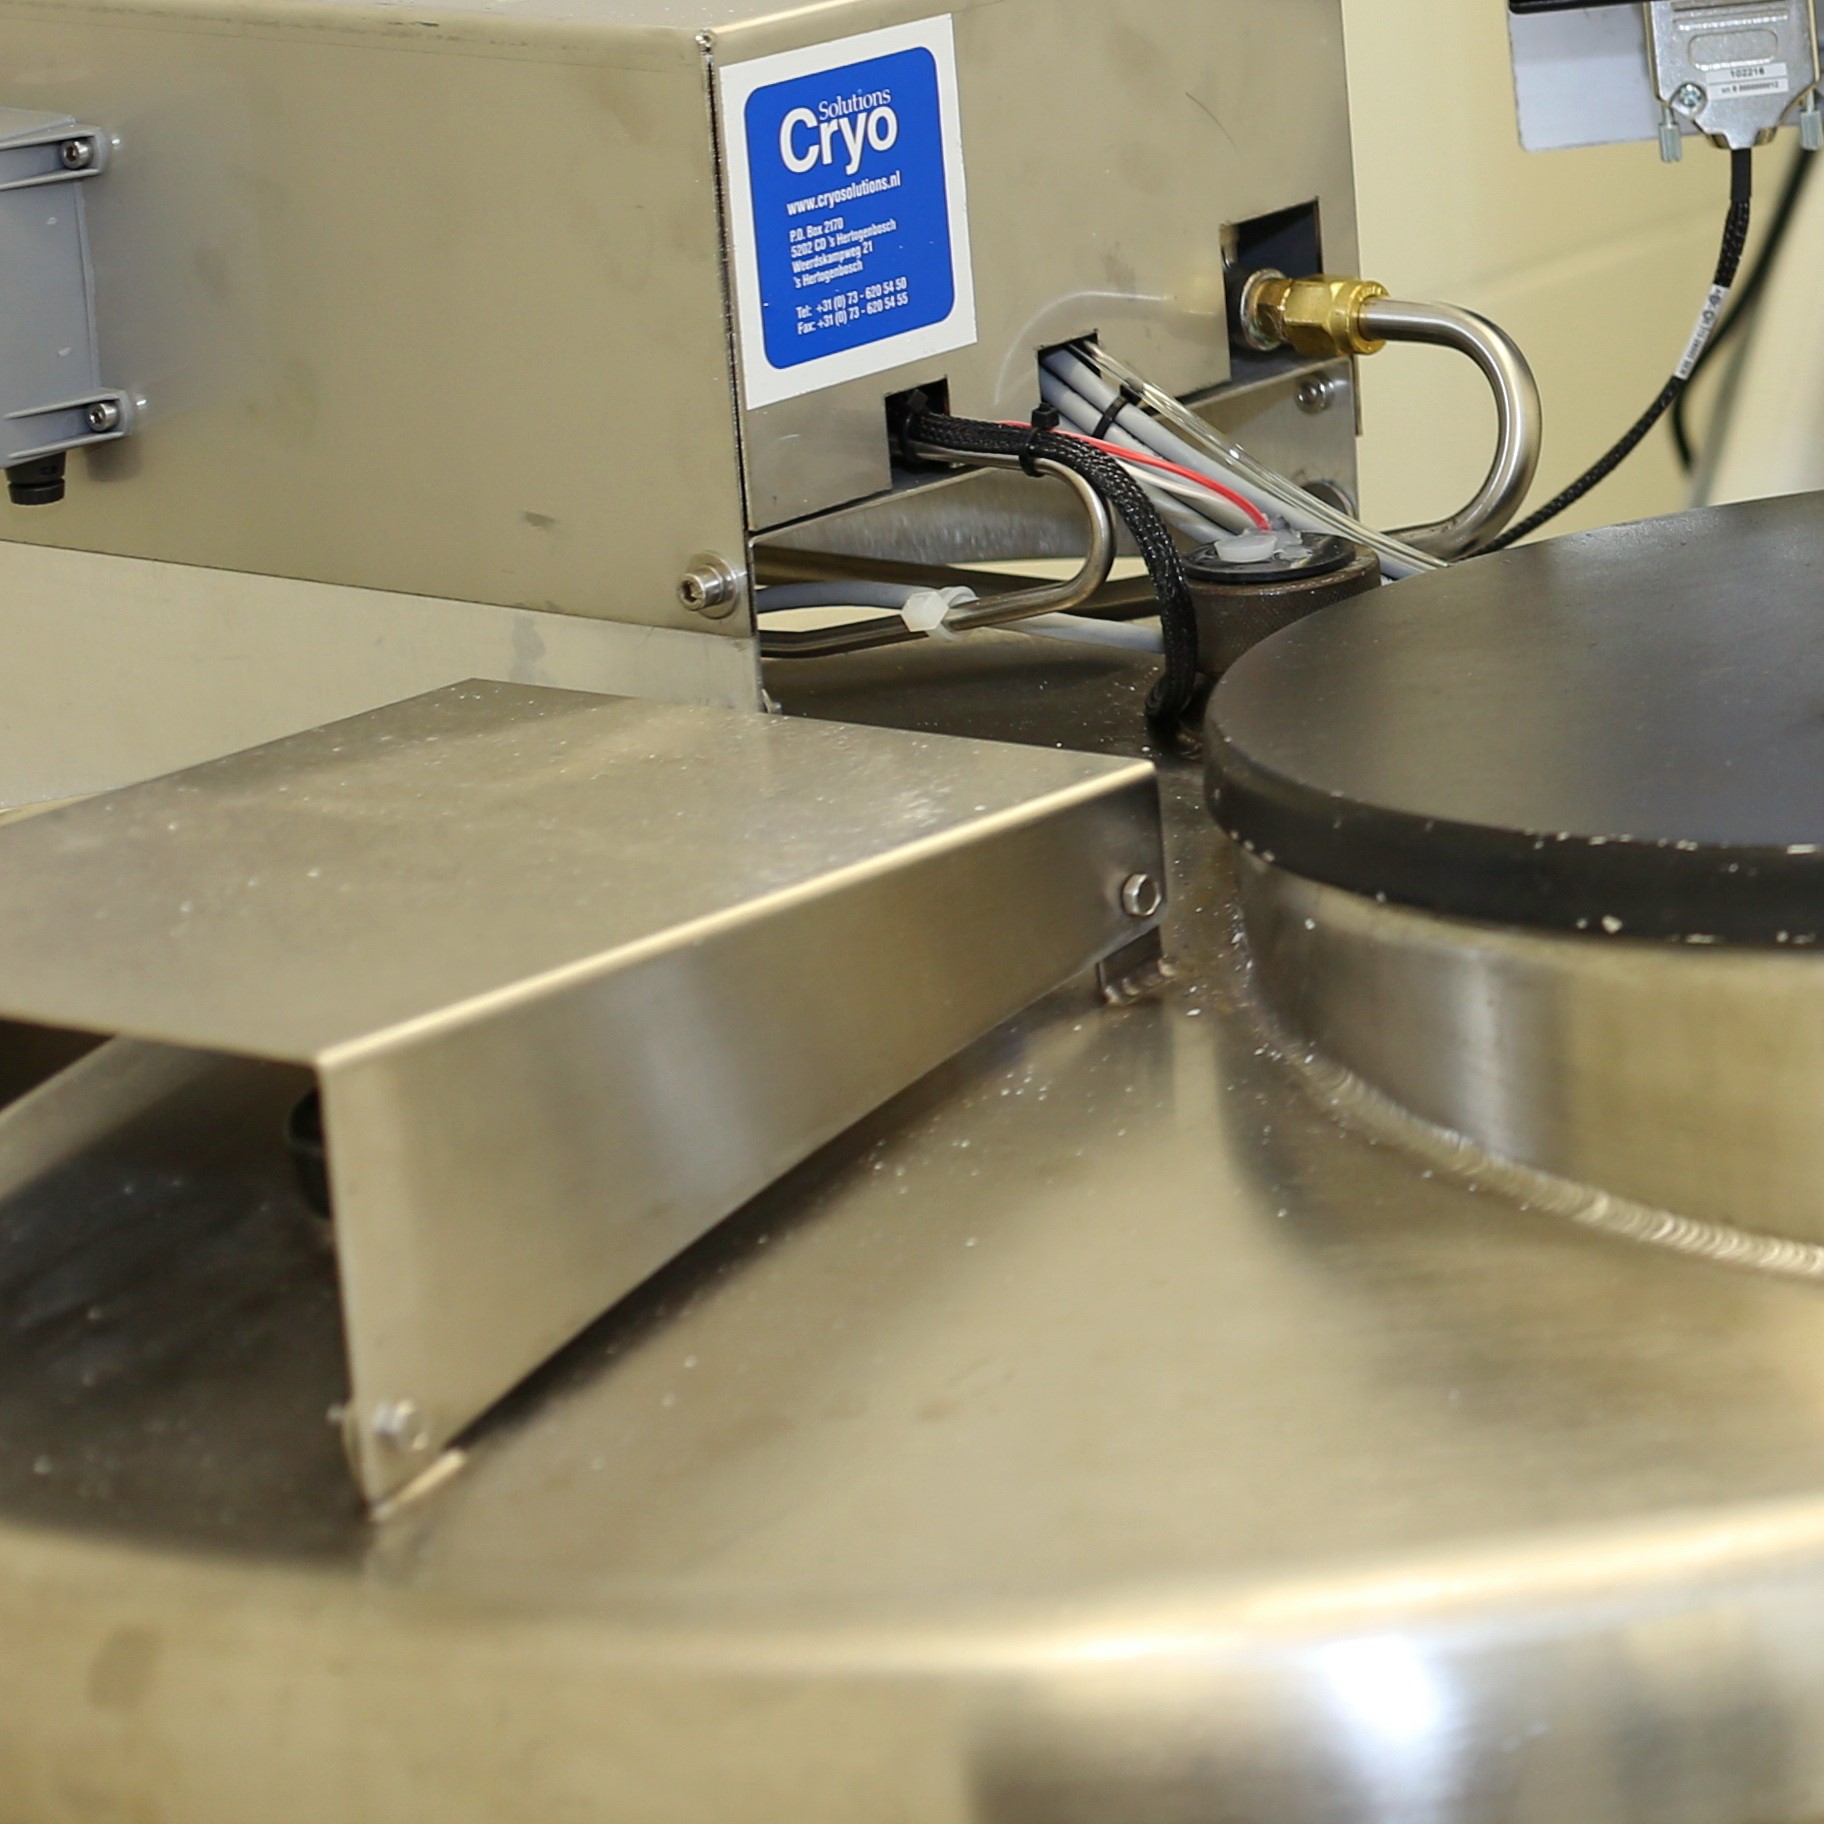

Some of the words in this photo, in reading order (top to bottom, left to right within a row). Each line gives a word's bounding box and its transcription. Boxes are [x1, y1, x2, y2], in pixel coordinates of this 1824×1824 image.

[818, 88, 892, 121] Solutions
[779, 105, 899, 175] Cryo
[787, 170, 901, 216] www.cryosolutions.nl
[862, 240, 874, 254] 21
[846, 290, 859, 305] 73
[847, 306, 860, 320] 73
